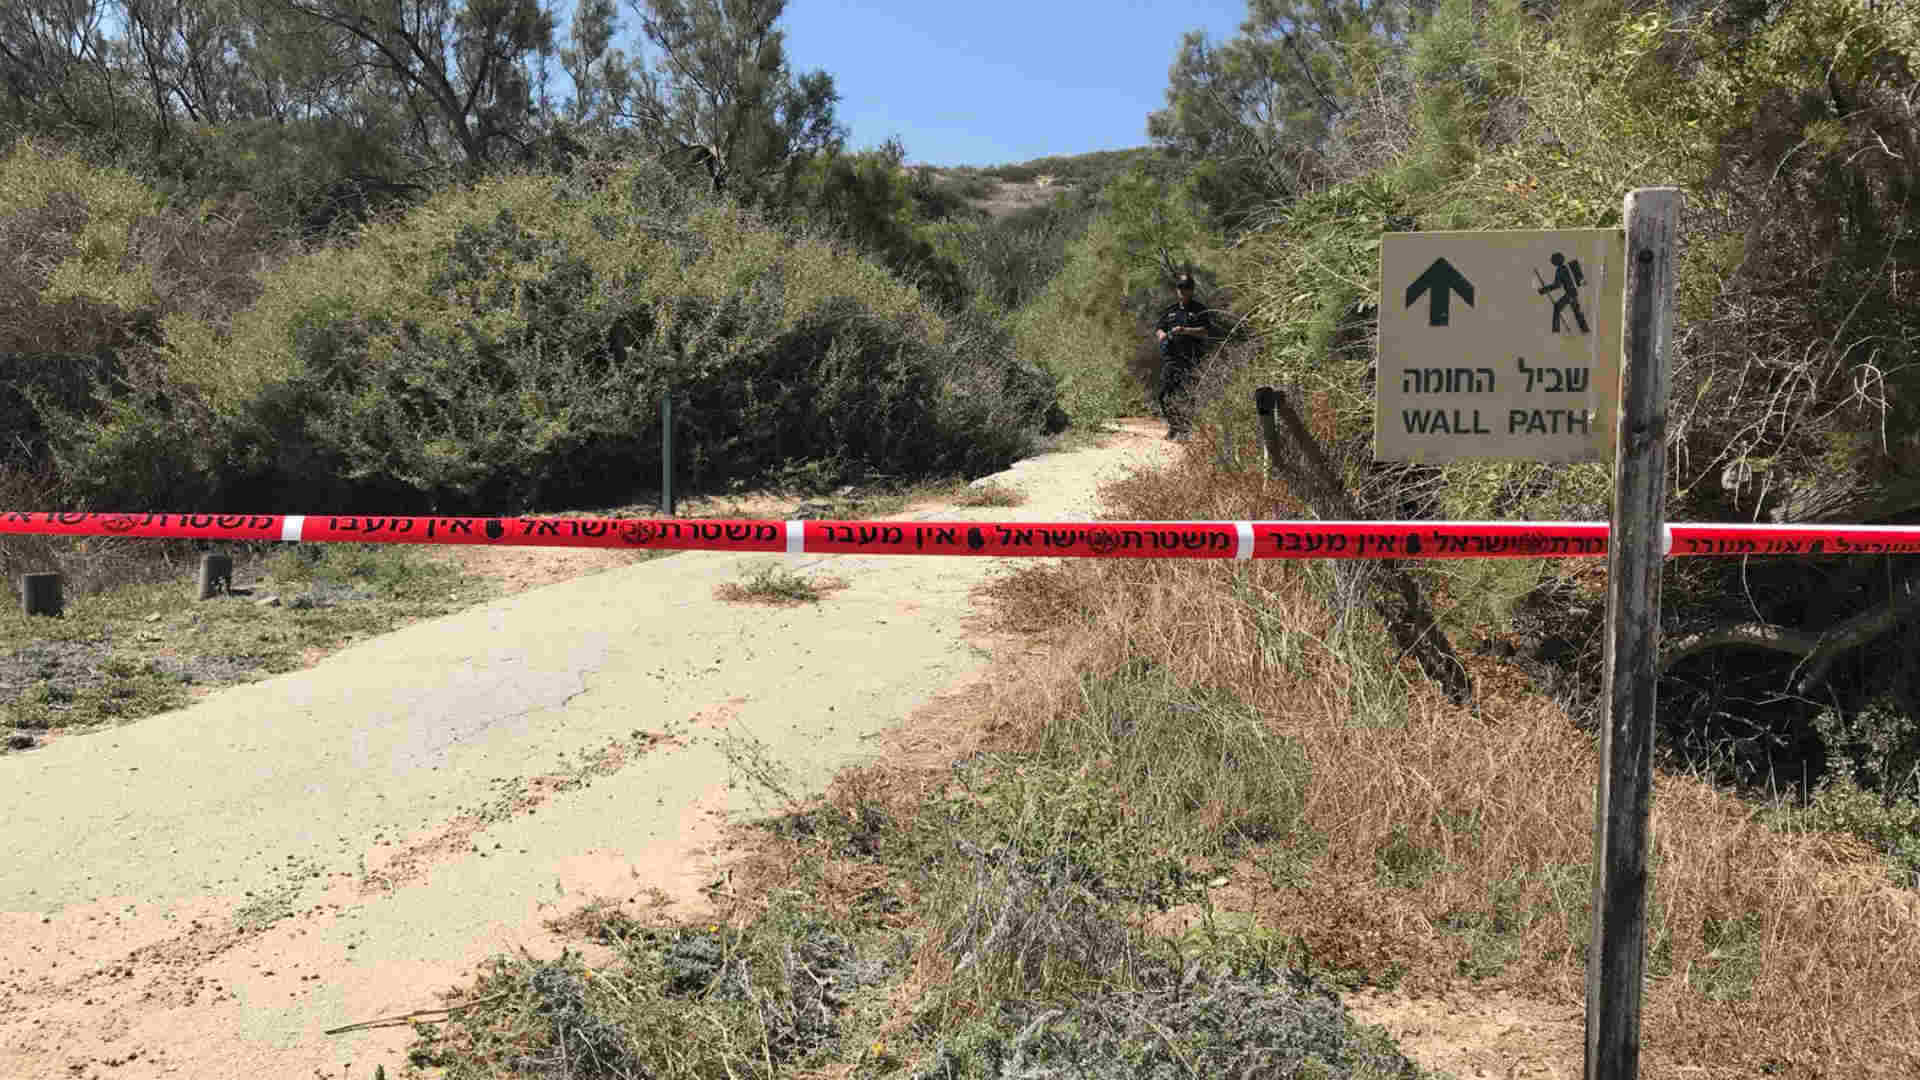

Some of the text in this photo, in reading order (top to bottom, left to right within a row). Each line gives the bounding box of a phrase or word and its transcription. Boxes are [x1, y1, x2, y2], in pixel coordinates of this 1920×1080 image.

[1402, 357, 1589, 393] שביל החומה
[1402, 409, 1589, 435] WALL PATH
[426, 518, 473, 538] אין
[518, 519, 778, 541] משטרת ישראל
[817, 523, 956, 550] אין מעבר
[994, 524, 1231, 550] משטרת ישראל
[1267, 530, 1396, 555] אין מעבר
[1432, 529, 1519, 553] ישראל
